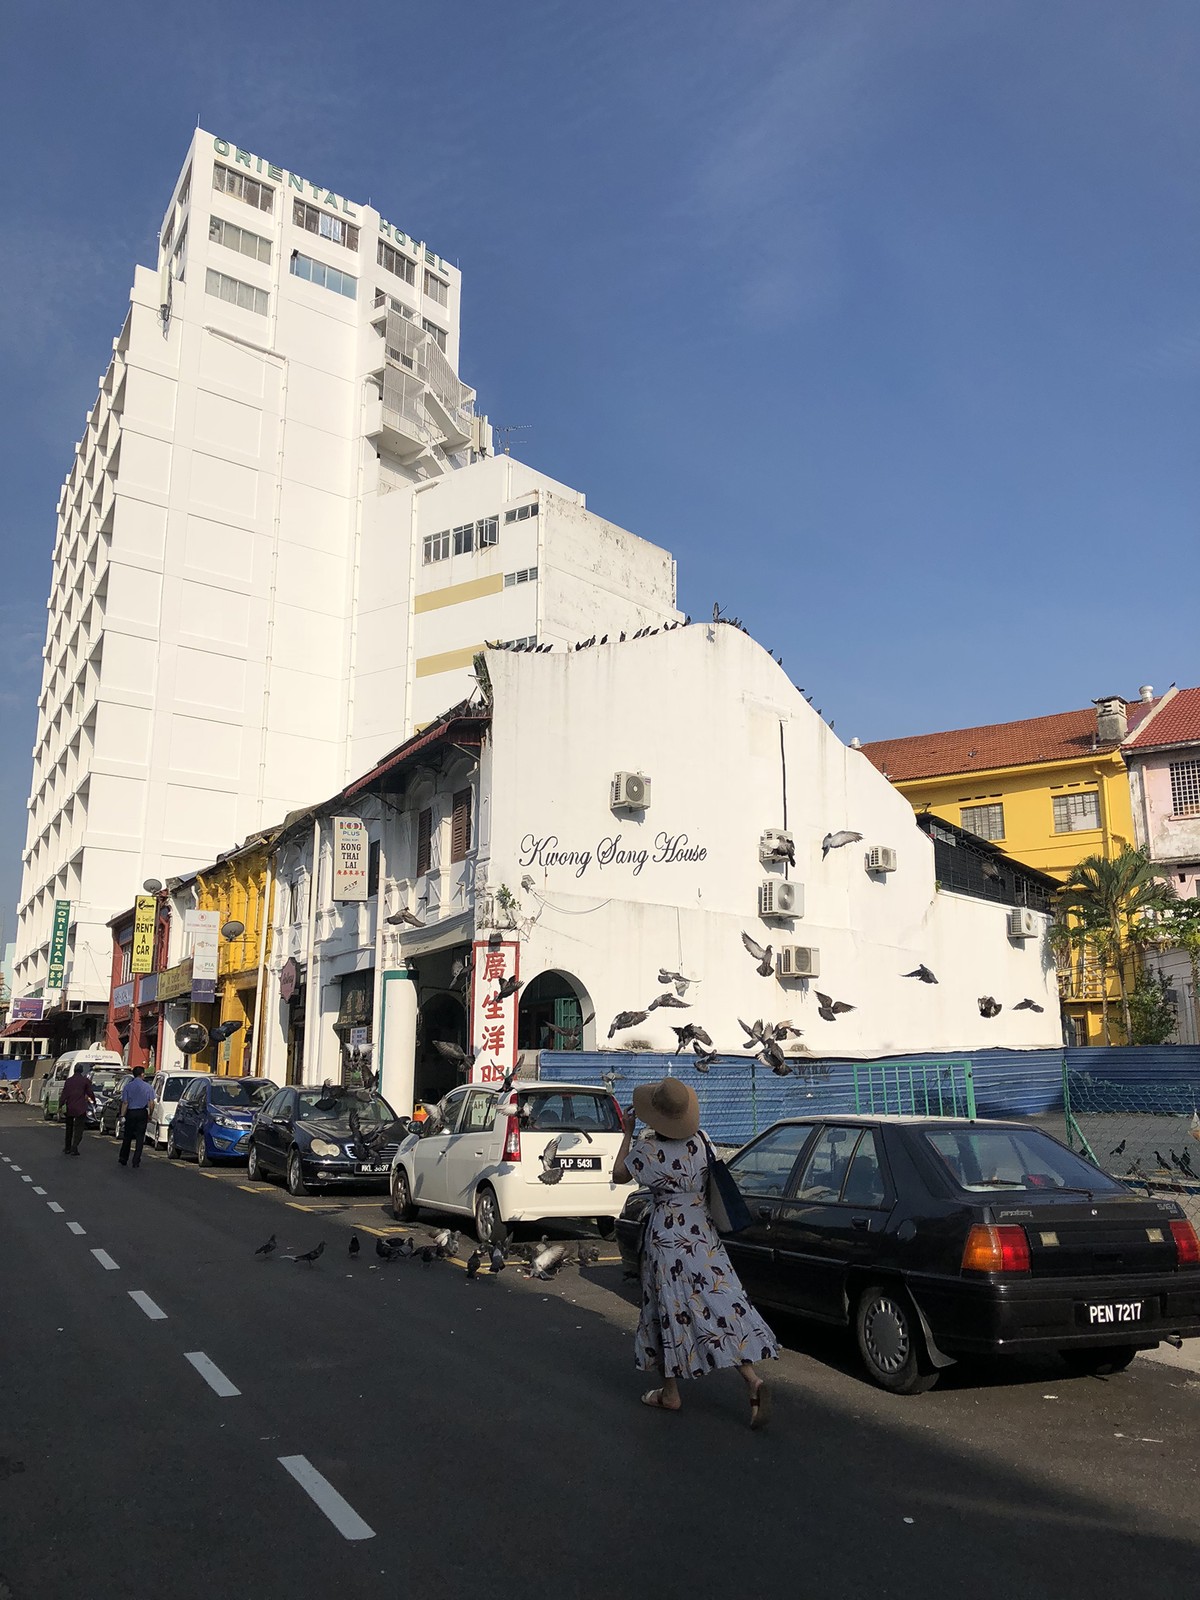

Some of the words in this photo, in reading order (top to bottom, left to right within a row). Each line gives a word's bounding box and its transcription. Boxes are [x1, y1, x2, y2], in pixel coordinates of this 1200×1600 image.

[213, 137, 357, 218] ORIENTAL
[380, 218, 450, 276] HOTEL
[341, 843, 361, 852] KONG
[342, 852, 359, 860] THAI
[519, 834, 592, 878] Kwong
[597, 834, 648, 876] Sang
[652, 832, 707, 863] House
[345, 861, 357, 869] LAI
[136, 923, 153, 934] RENT
[53, 911, 67, 964] ORIENTAL
[141, 934, 147, 944] A
[136, 945, 150, 955] CAR
[560, 1158, 574, 1168] PLP
[576, 1158, 593, 1168] 5431
[1089, 1304, 1114, 1324] PEN
[1115, 1302, 1142, 1322] 7217
